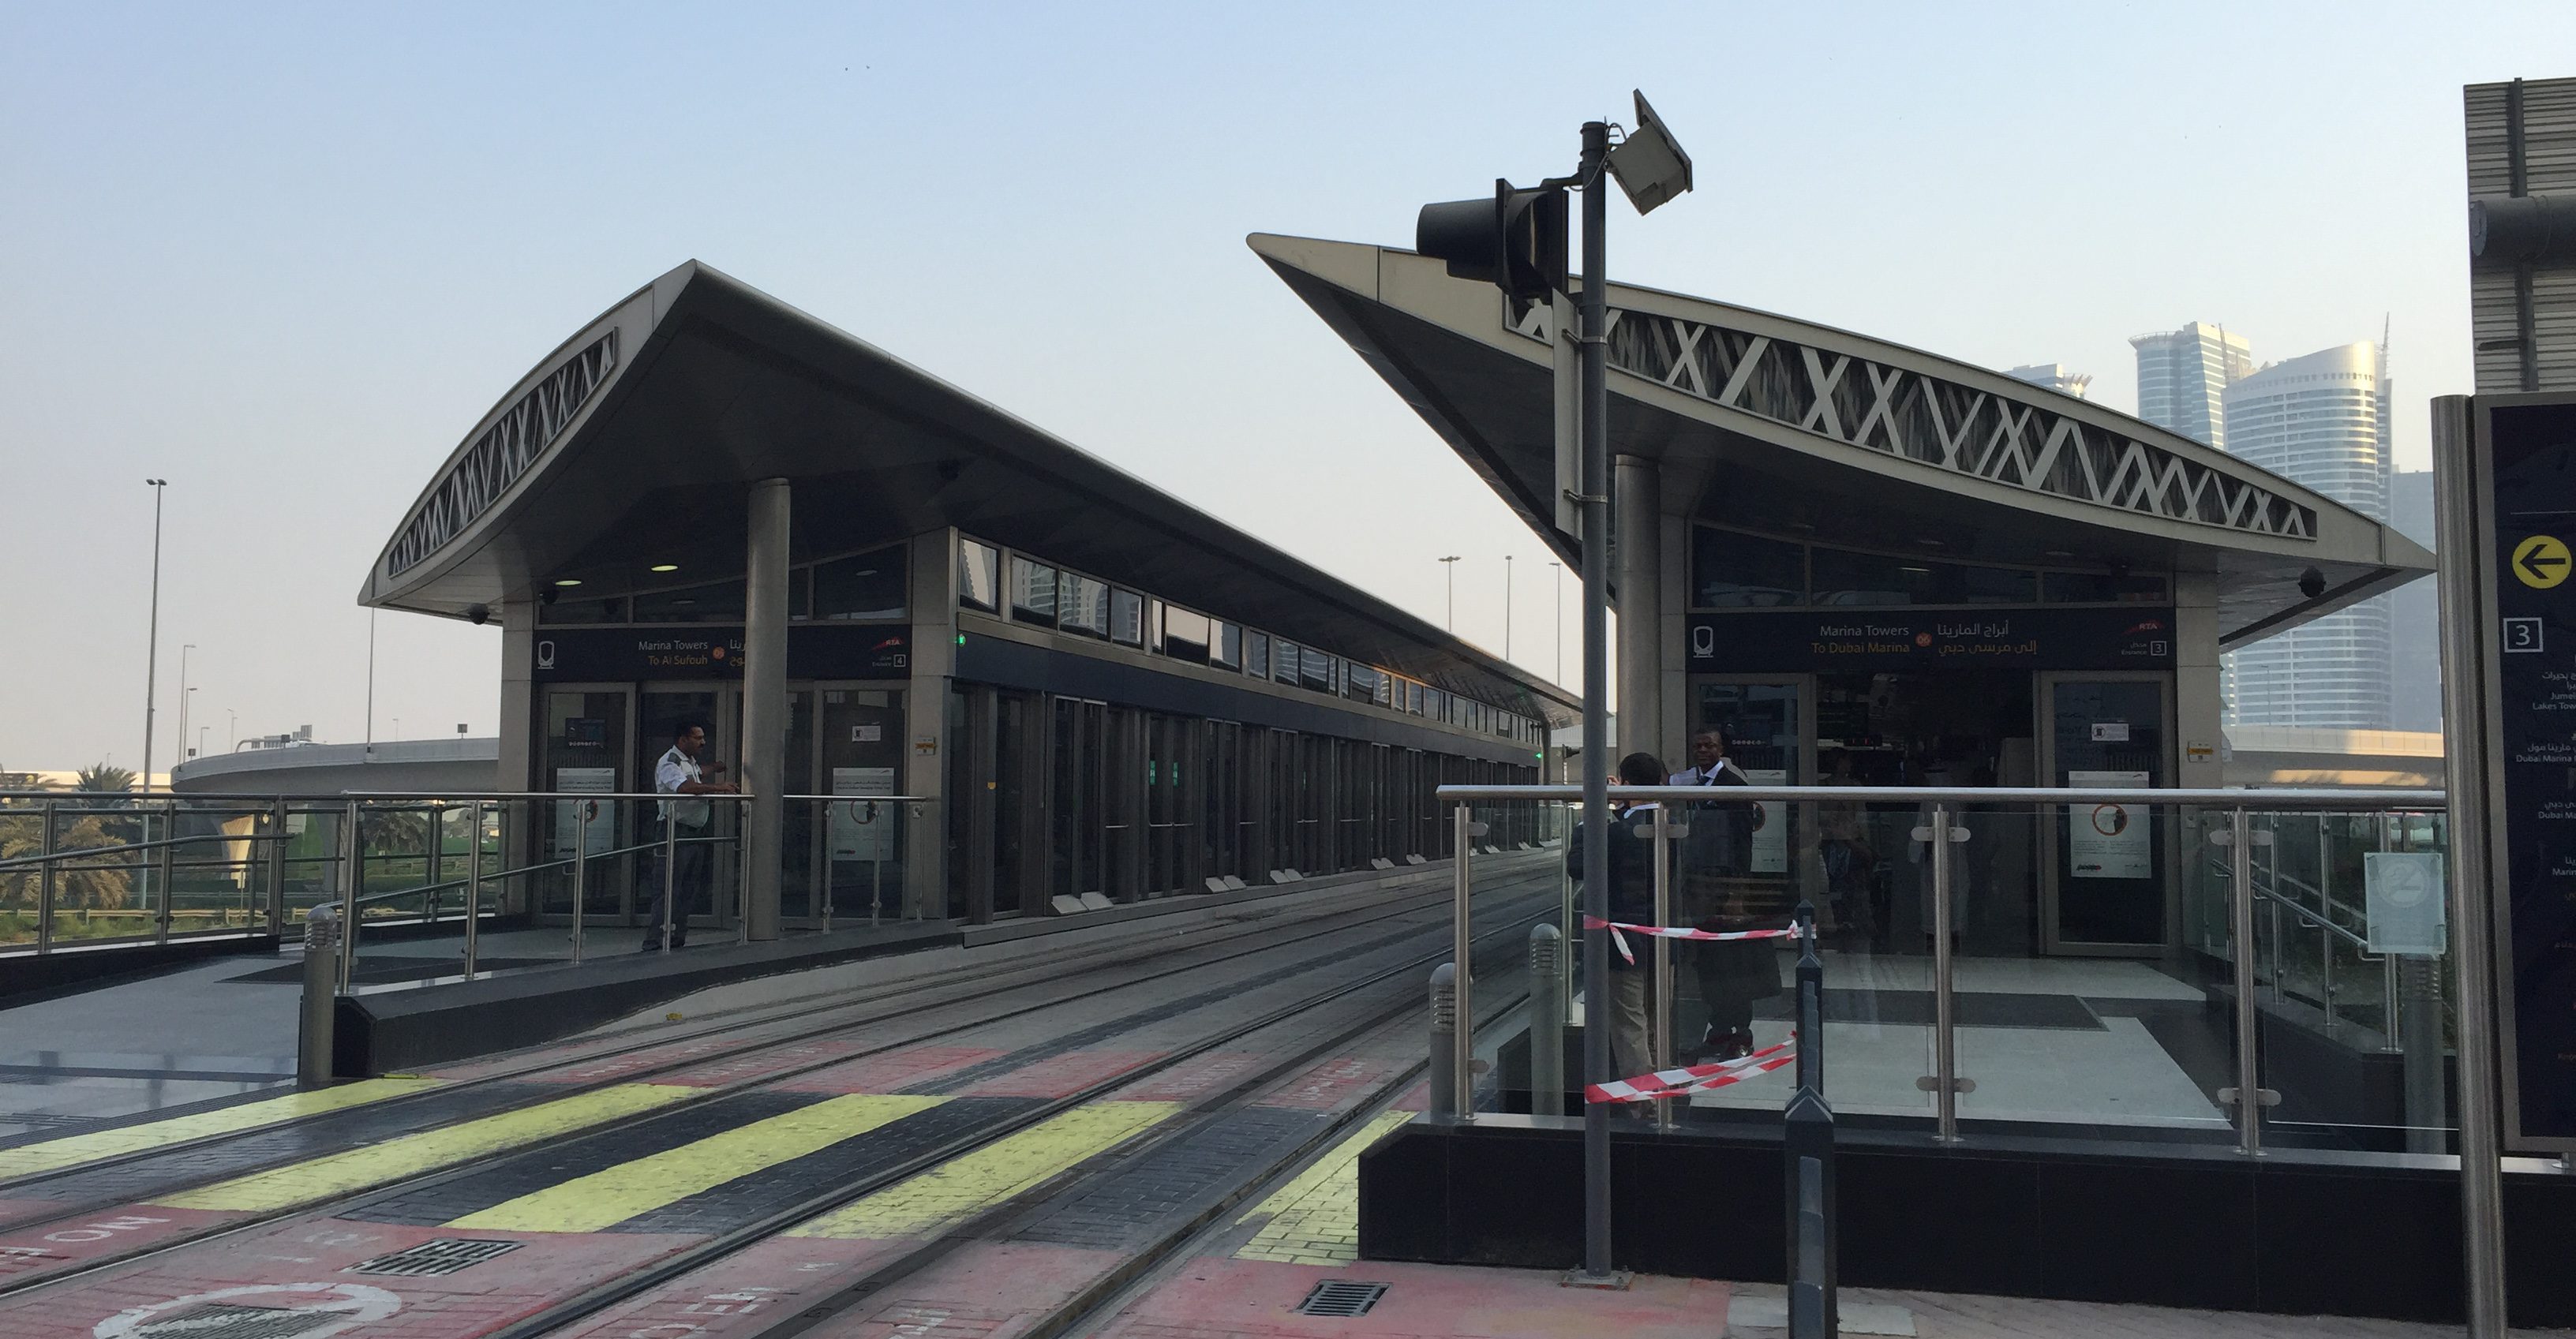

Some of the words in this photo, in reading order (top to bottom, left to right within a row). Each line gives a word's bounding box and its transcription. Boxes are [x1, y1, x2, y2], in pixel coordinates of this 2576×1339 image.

[1820, 625, 1862, 637] Marina
[1865, 625, 1910, 637] Towers
[1938, 623, 1981, 638] المارينا
[1983, 620, 2009, 638] أبراج
[2515, 624, 2531, 645] 3
[638, 640, 672, 651] Marina
[674, 640, 708, 651] Towers
[1811, 641, 1826, 654] To
[1829, 641, 1864, 654] Dubai
[1867, 641, 1911, 654] Marina
[1938, 644, 1966, 657] دبي
[1968, 643, 2012, 656] مرسى
[2013, 640, 2038, 655] إلى
[647, 655, 659, 666] To
[673, 654, 708, 666] Sufouh
[2532, 701, 2558, 711] Lakes
[2515, 754, 2541, 763] Dubai
[2542, 754, 2573, 763] Marina
[2537, 810, 2563, 819] Dubai
